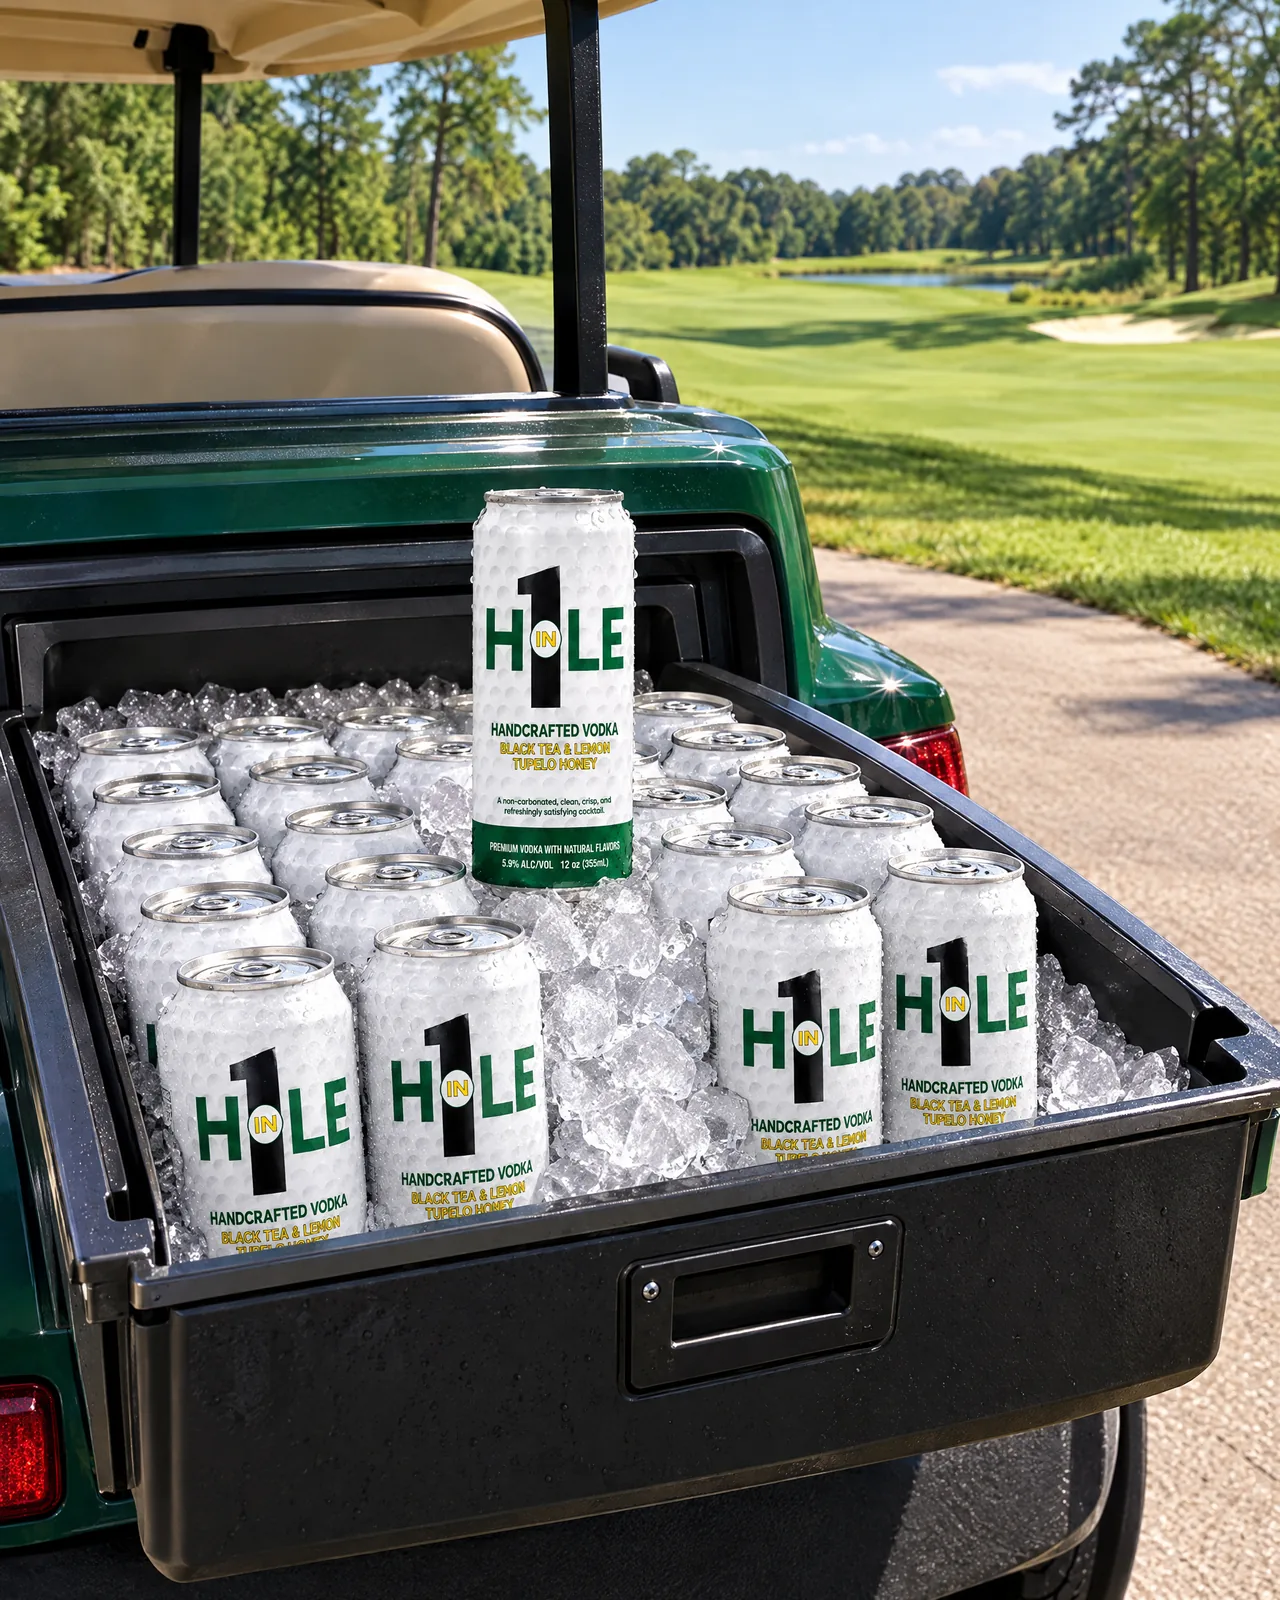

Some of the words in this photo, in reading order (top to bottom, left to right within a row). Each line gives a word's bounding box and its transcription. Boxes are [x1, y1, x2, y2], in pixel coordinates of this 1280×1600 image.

[517, 565, 561, 708] 1
[535, 630, 557, 647] IN
[491, 722, 580, 737] HANDCRAFTED
[582, 722, 619, 737] VODKA
[499, 742, 535, 755] BLACK
[538, 743, 561, 755] TEA
[563, 743, 572, 755] &
[573, 741, 611, 755] LEMON
[512, 757, 557, 771] TUPELO
[559, 757, 598, 770] HONEY
[503, 797, 559, 806] non-carbonated,
[560, 798, 581, 806] clean,
[581, 798, 599, 808] crisp,
[600, 796, 612, 804] and
[504, 807, 543, 817] refreshingly
[543, 807, 578, 817] satisfying
[578, 807, 606, 815] cocktail.
[489, 841, 519, 854] PREMIUM
[520, 844, 543, 854] VODKA
[544, 845, 562, 854] WITH
[563, 842, 595, 855] NATURAL
[595, 840, 621, 852] FLAVORS
[501, 858, 520, 868] 5.9%
[520, 860, 554, 870] ALC/VOL
[560, 860, 571, 869] 12
[571, 861, 581, 869] oz
[582, 858, 610, 870] (355mL)
[926, 937, 971, 1066] 1
[945, 996, 965, 1012] IN
[778, 969, 824, 1104] 1
[798, 1030, 818, 1046] IN
[424, 1013, 476, 1157] 1
[446, 1080, 468, 1097] IN
[901, 1078, 988, 1094] HANDCRAFTED
[991, 1076, 1024, 1093] VODKA
[910, 1097, 945, 1112] BLACK
[948, 1099, 971, 1112] TEA
[973, 1099, 982, 1111] &
[983, 1095, 1017, 1111] LEMON
[229, 1046, 287, 1196] 1
[254, 1115, 278, 1134] IN
[751, 1117, 841, 1133] HANDCRAFTED
[843, 1110, 873, 1129] VODKA
[923, 1113, 966, 1126] TUPELO
[968, 1111, 1006, 1125] HONEY
[761, 1137, 799, 1150] BLACK
[801, 1138, 824, 1150] TEA
[826, 1136, 834, 1148] &
[836, 1130, 867, 1147] LEMON
[401, 1168, 495, 1186] HANDCRAFTED
[498, 1160, 533, 1180] VODKA
[411, 1191, 449, 1205] BLACK
[452, 1190, 477, 1203] TEA
[479, 1189, 487, 1201] &
[490, 1180, 526, 1200] LEMON
[210, 1204, 307, 1225] HANDCRAFTED
[310, 1193, 348, 1215] VODKA
[425, 1205, 472, 1220] TUPELO
[474, 1198, 514, 1214] HONEY
[221, 1230, 261, 1245] BLACK
[263, 1227, 289, 1242] TEA
[291, 1225, 300, 1238] &
[303, 1215, 341, 1236] LEMON
